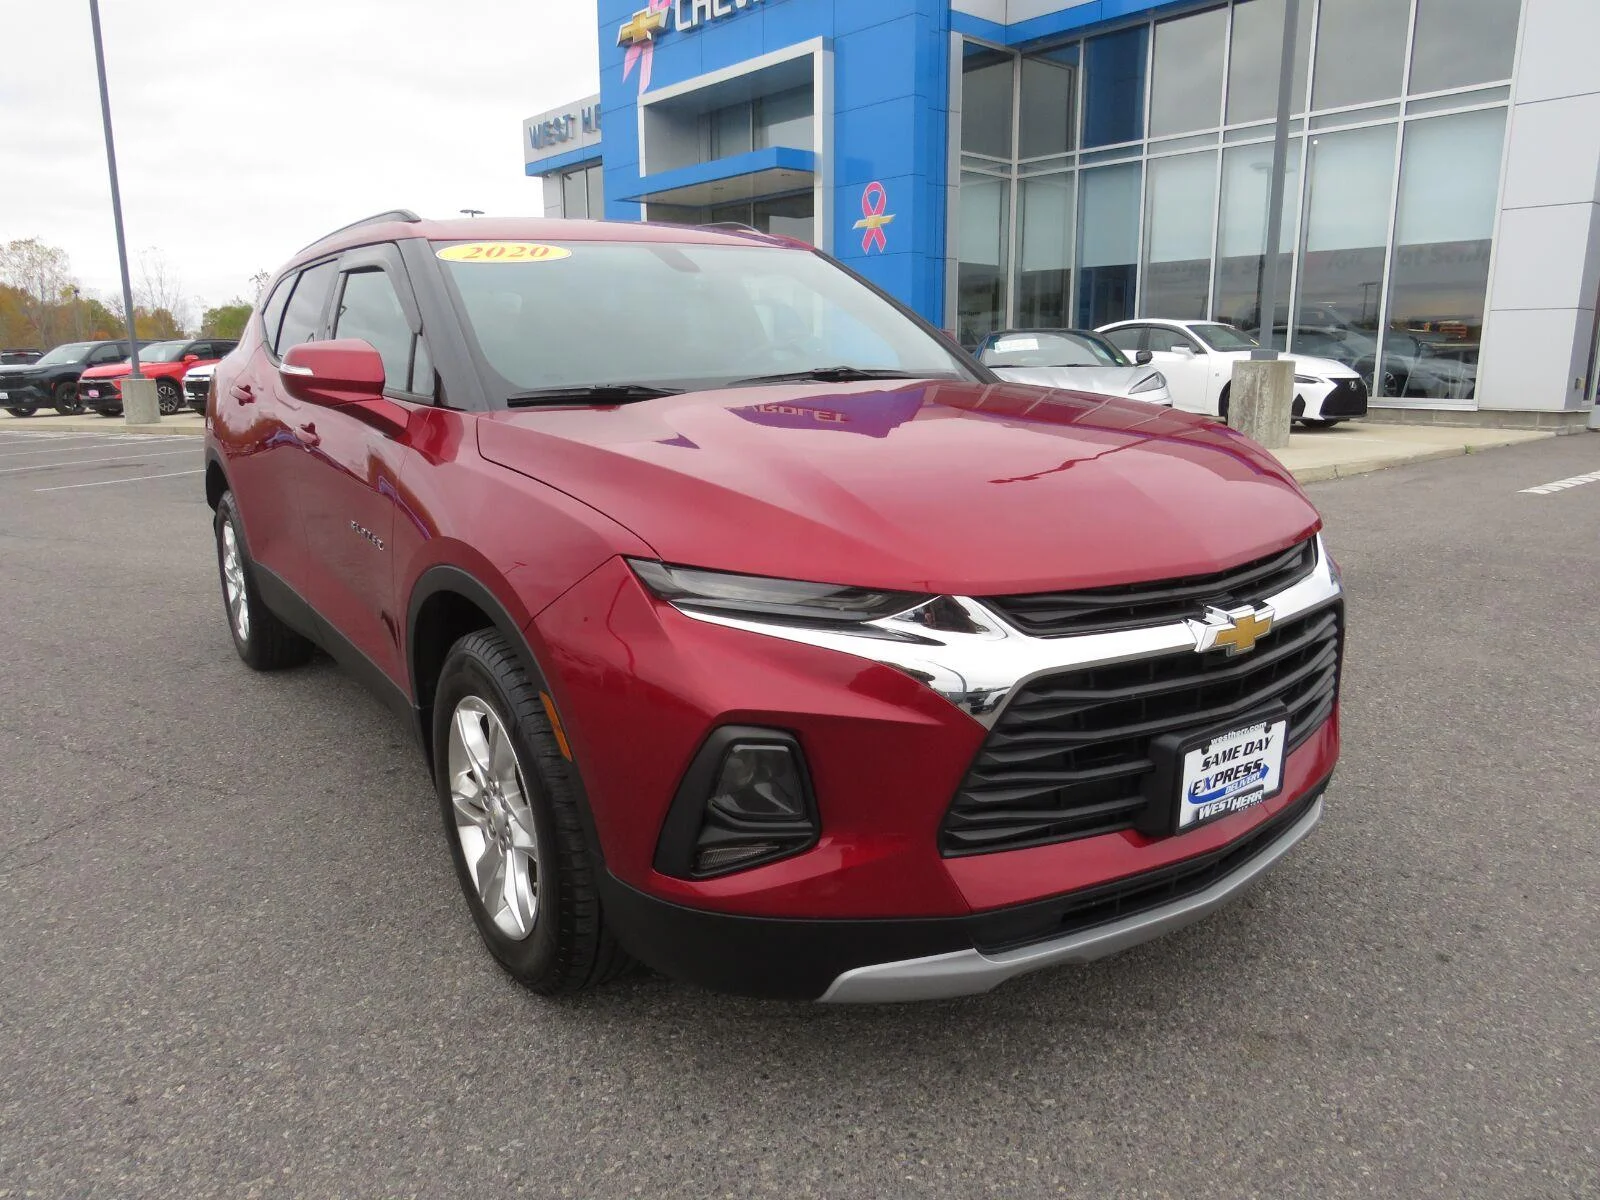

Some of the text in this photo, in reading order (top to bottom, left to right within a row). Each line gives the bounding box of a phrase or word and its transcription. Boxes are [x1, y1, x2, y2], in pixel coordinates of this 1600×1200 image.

[528, 113, 575, 149] WEST
[462, 246, 550, 259] 2020
[1201, 735, 1274, 772] SAME DAY
[1192, 758, 1264, 796] EXPRESS
[1198, 789, 1264, 820] WESTHERR
